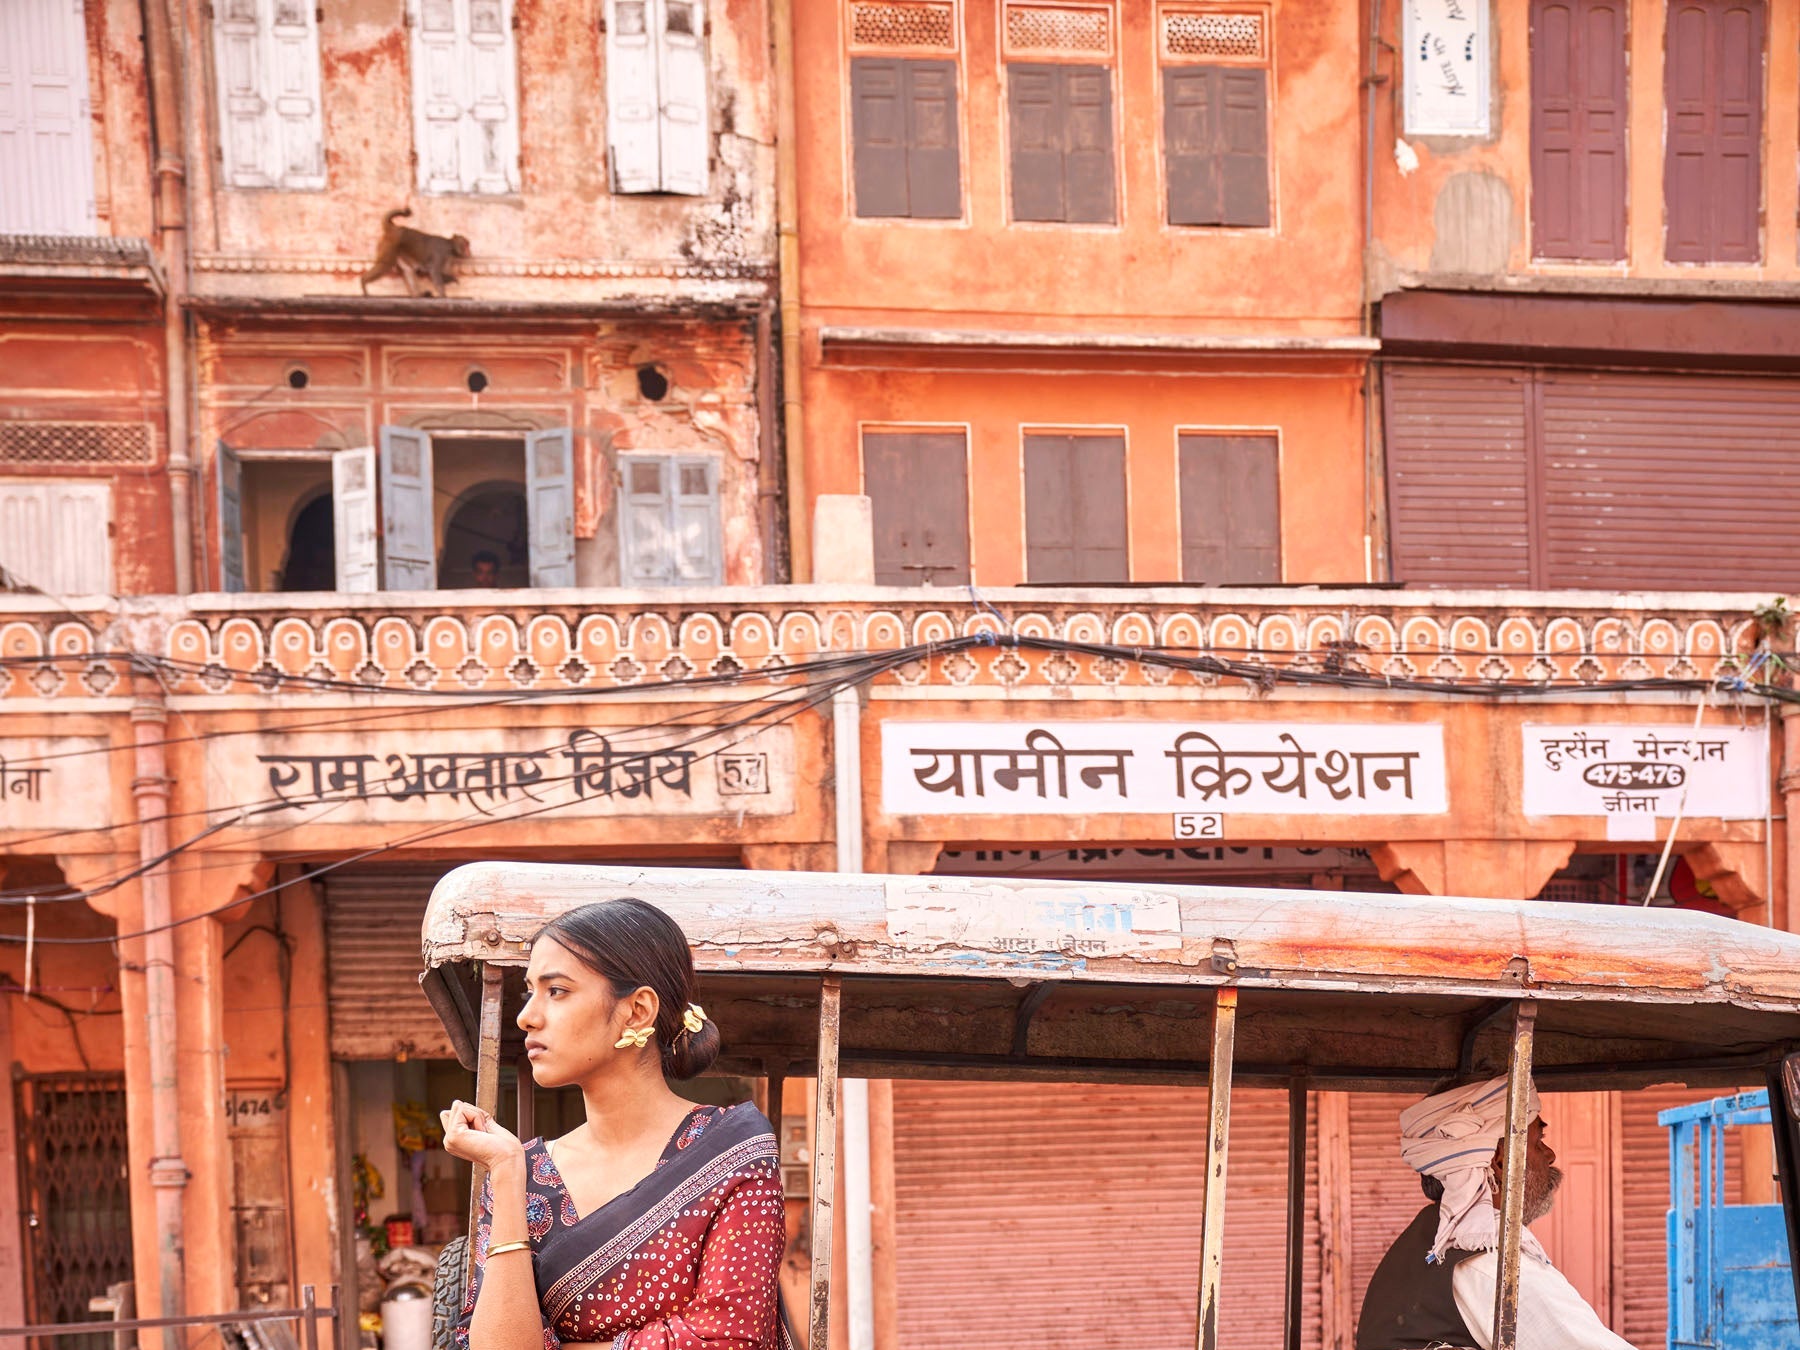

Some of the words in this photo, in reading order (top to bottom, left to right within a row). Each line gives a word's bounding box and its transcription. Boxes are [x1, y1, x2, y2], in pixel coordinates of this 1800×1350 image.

[909, 728, 1135, 799] यामीन
[1164, 731, 1421, 802] क्रियेशन
[1540, 731, 1610, 771] हुसैन
[256, 754, 380, 809] राम
[385, 753, 553, 816] अवतार
[561, 729, 698, 801] विजय
[1585, 764, 1683, 785] 475-476
[1602, 791, 1660, 812] जीना
[1179, 815, 1217, 837] 52
